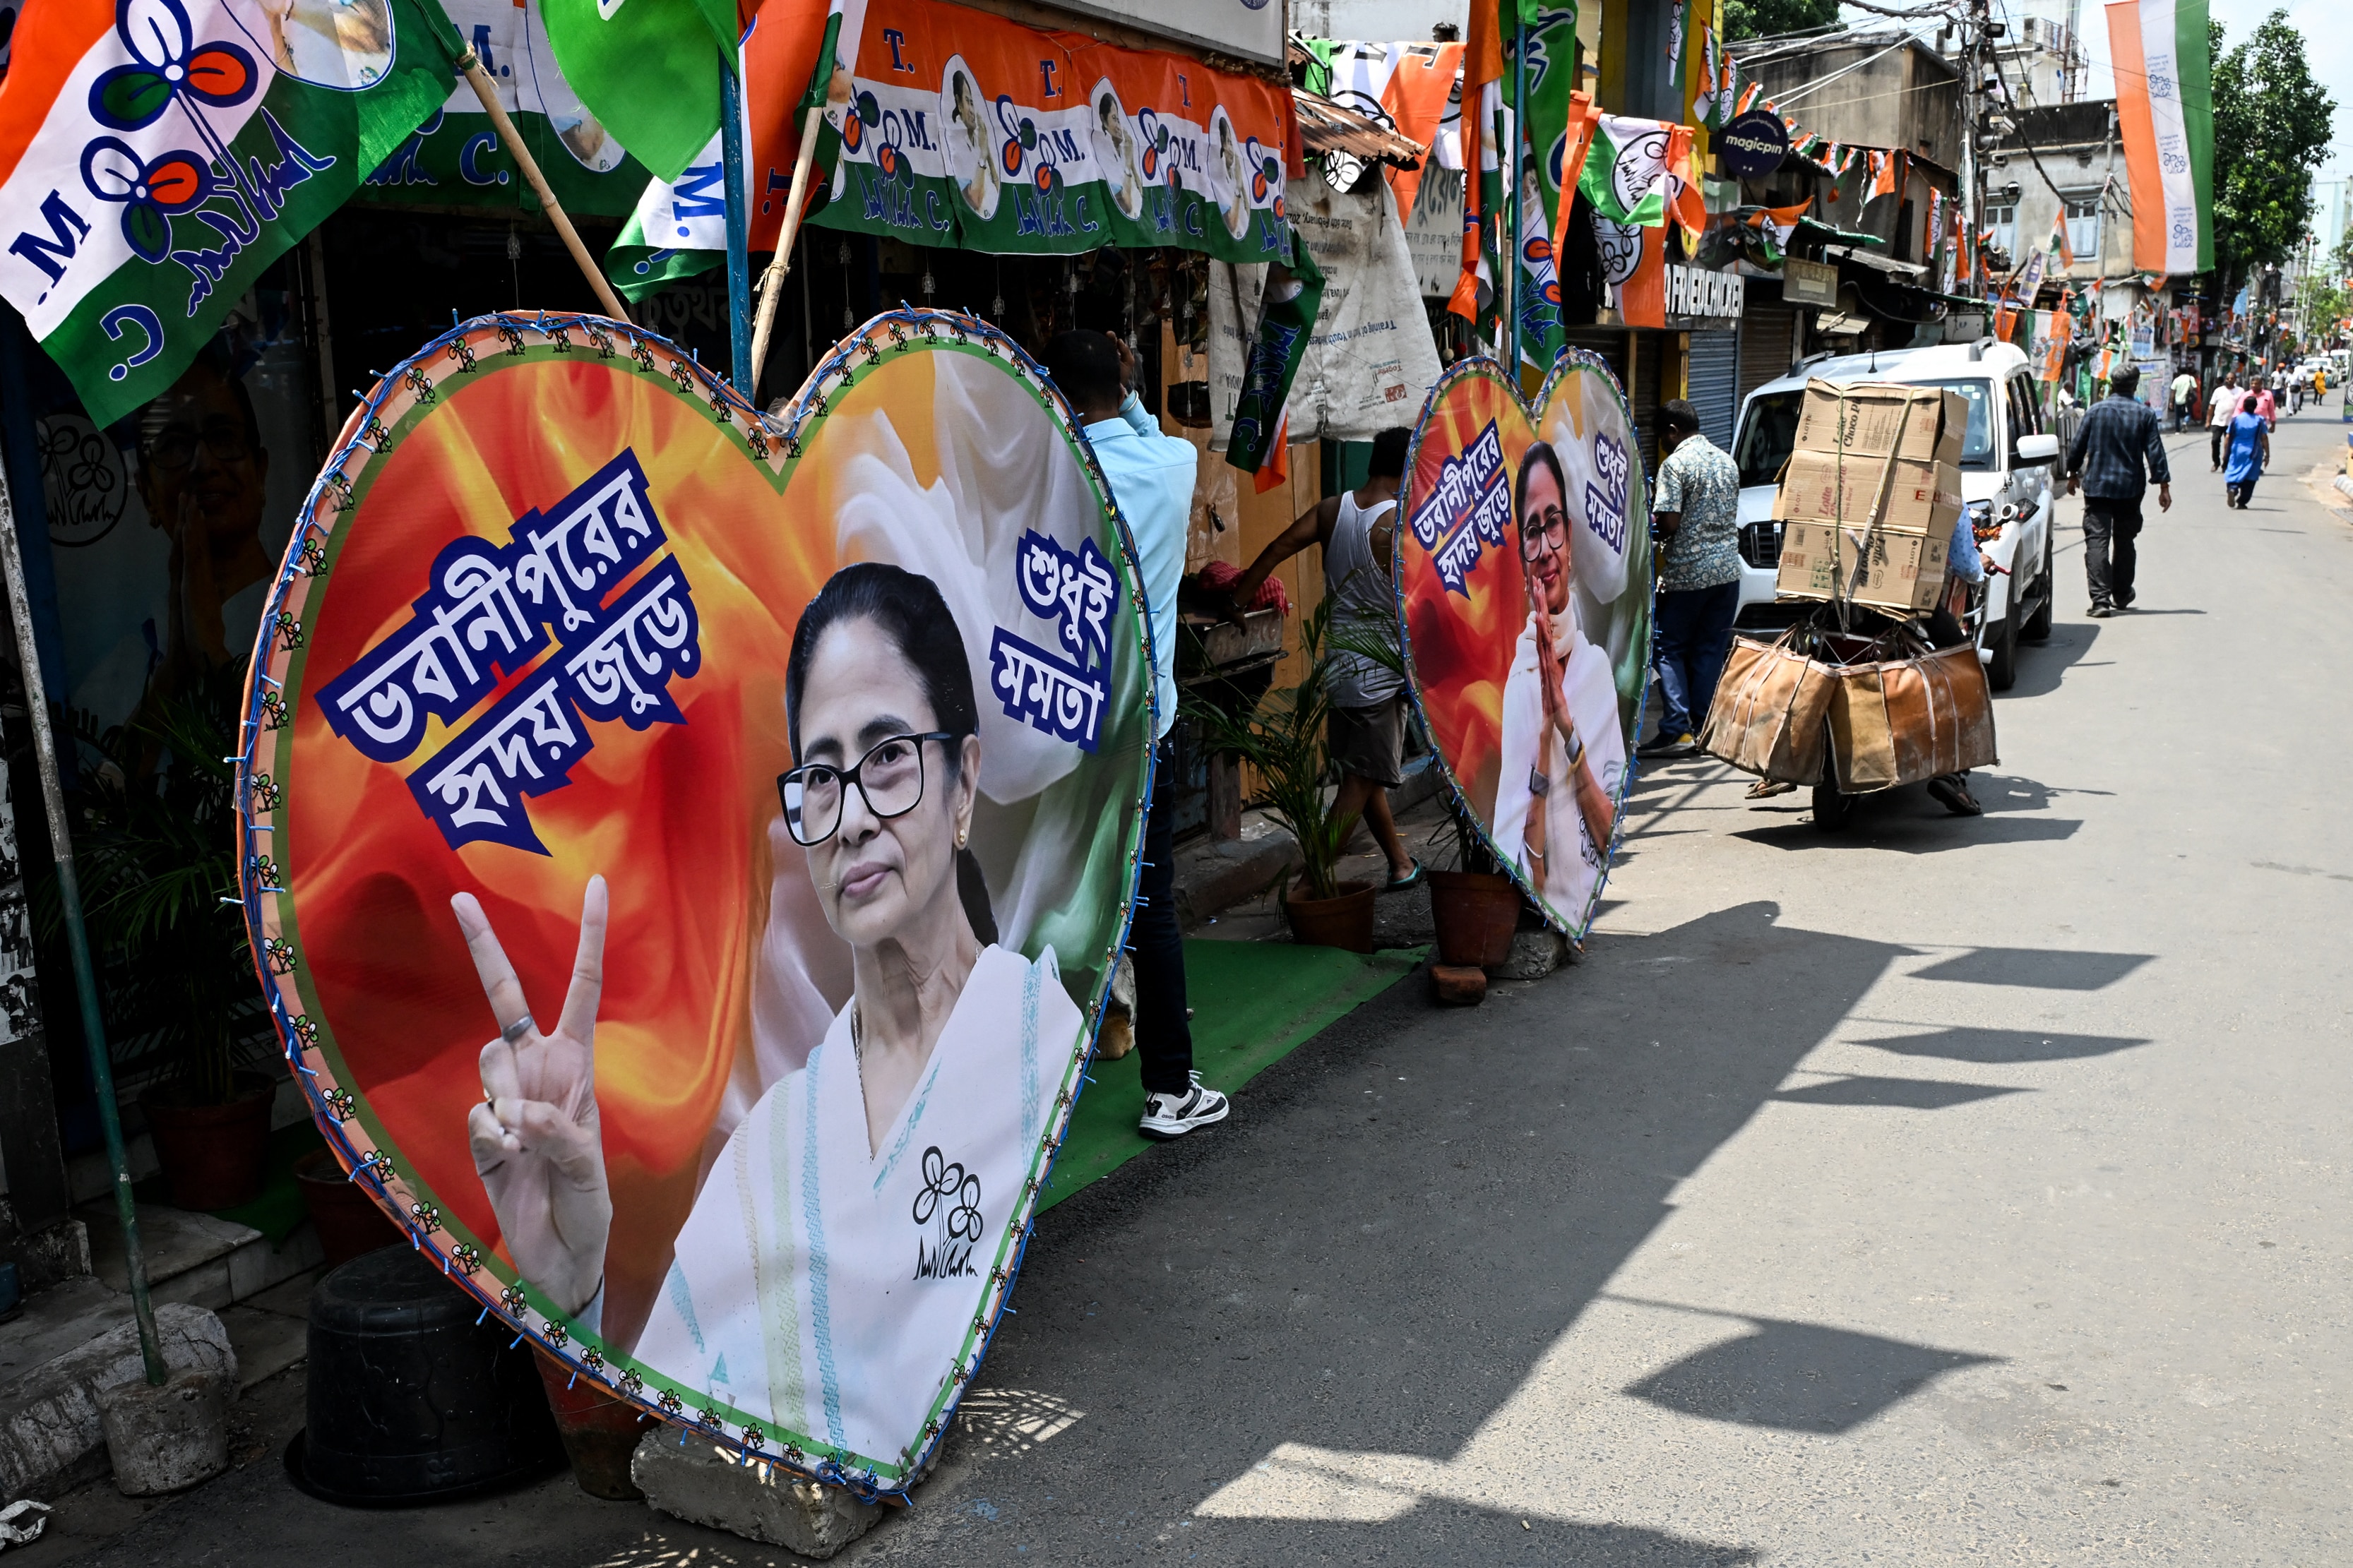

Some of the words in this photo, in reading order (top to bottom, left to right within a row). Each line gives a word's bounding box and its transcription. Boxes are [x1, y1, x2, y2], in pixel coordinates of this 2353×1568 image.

[883, 28, 915, 73] T.
[902, 109, 937, 152] M.
[1052, 130, 1085, 162] M.
[1725, 135, 1782, 155] magicpin
[1368, 320, 1398, 335] Training
[1843, 414, 1858, 448] Choco
[1414, 426, 1501, 544] ভবানীপুরের
[1818, 486, 1833, 517] Lotte
[1438, 520, 1479, 585] হৃদয়
[1475, 477, 1511, 541] জুড়ে
[1588, 488, 1624, 548] মমতা
[1871, 537, 1886, 566] Lotte
[336, 469, 652, 743] ভবানীপুরের
[1023, 543, 1114, 654] শুধুই
[426, 676, 578, 829] হৃদয়
[566, 574, 690, 715] জুড়ে
[999, 640, 1105, 741] মমতা
